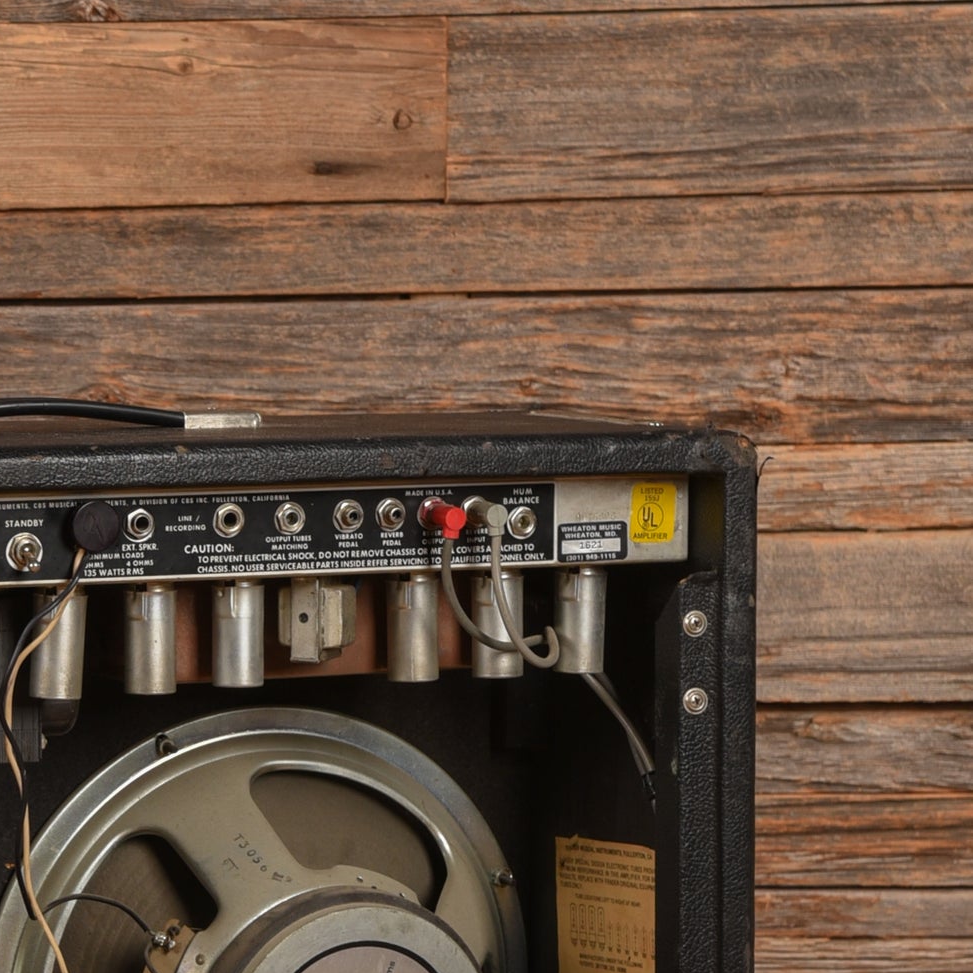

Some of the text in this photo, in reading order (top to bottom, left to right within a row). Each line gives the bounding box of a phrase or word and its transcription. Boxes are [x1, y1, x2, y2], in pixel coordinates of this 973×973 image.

[252, 494, 290, 502] CALIFORNIA
[503, 496, 539, 504] BALANCE
[5, 519, 44, 528] STANDBY
[165, 524, 206, 532] RECORDING
[381, 531, 404, 539] REVERB
[382, 539, 401, 547] PEDAL
[579, 541, 603, 549] 1621
[122, 543, 159, 552] EXT. SPKR.
[184, 544, 234, 554] CAUTION:
[198, 554, 208, 563] TO
[210, 554, 243, 562] PREVENT
[244, 552, 286, 562] ELECTRICAL
[288, 552, 316, 561] SHOCK,
[319, 551, 331, 560] DO
[333, 550, 349, 559] NOT
[351, 549, 384, 558] REMOVE
[386, 548, 416, 557] CHASSIS
[418, 548, 428, 556] OR
[231, 564, 244, 572] NO
[245, 563, 265, 572] USER
[266, 561, 314, 571] SERVICEABLE
[316, 560, 339, 569] PARTS
[341, 559, 365, 568] INSIDE
[367, 558, 388, 567] REFER
[389, 557, 429, 566] SERVICING
[524, 552, 546, 560] ONLY.
[99, 568, 125, 576] WATTS
